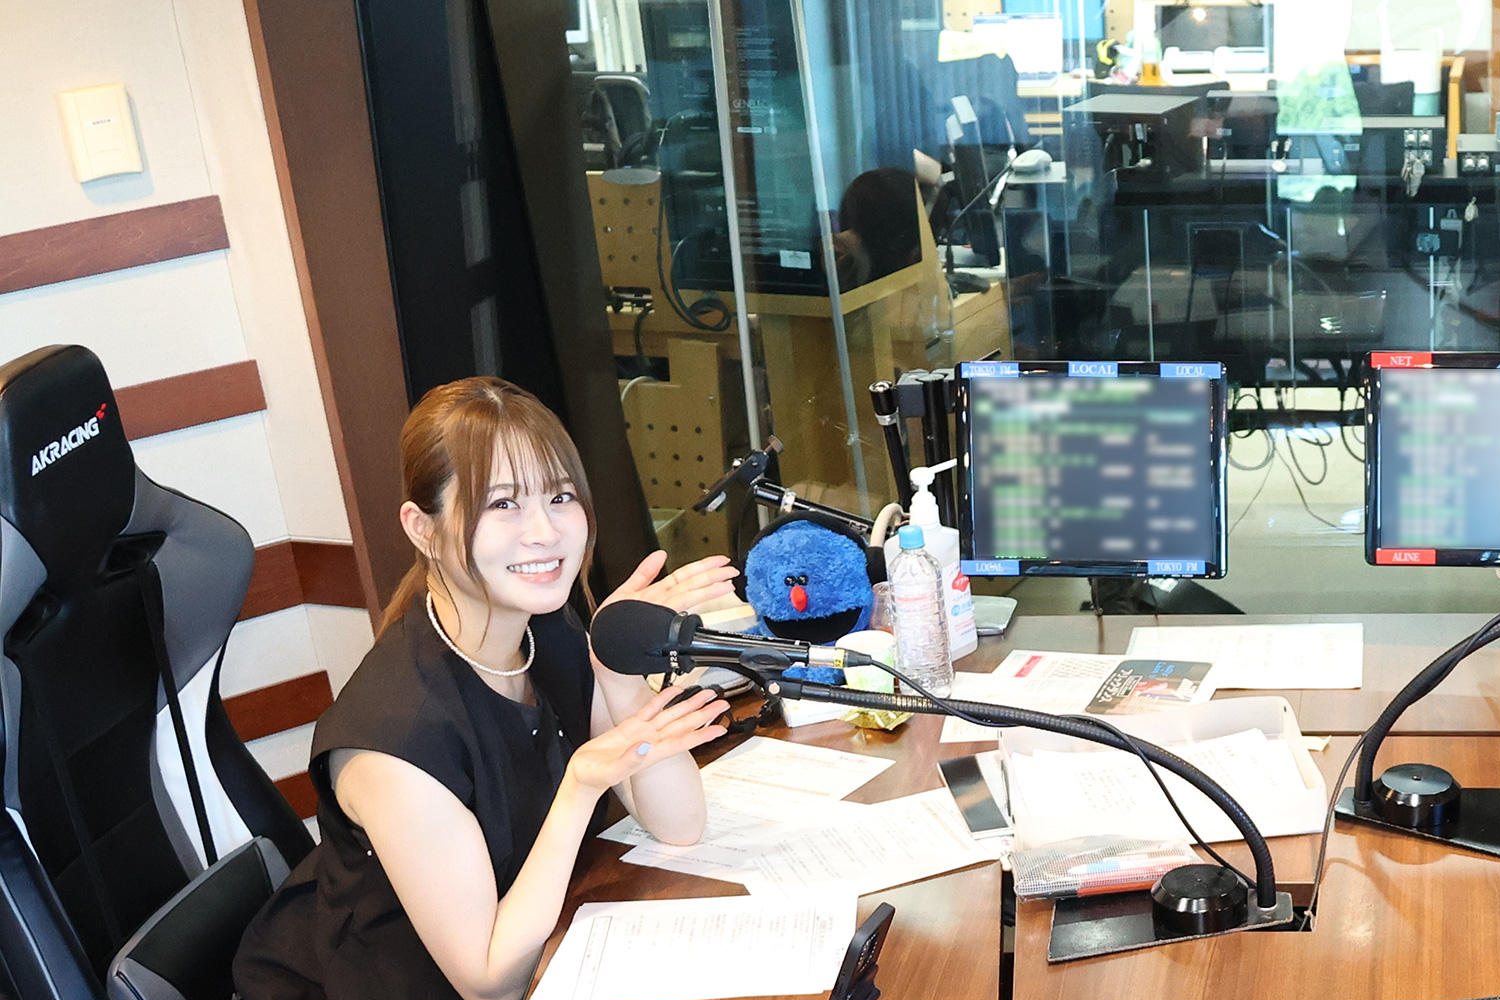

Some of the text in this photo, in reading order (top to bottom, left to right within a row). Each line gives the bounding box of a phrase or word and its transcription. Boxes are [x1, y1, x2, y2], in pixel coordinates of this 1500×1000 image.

[1389, 355, 1414, 366] NET
[1071, 363, 1116, 376] LOCAL
[1175, 365, 1206, 376] LOCAL
[31, 416, 101, 477] AKRACING
[1392, 552, 1421, 563] ALINE
[975, 562, 1004, 573] LOCAL
[1155, 562, 1198, 573] TOKYO FM
